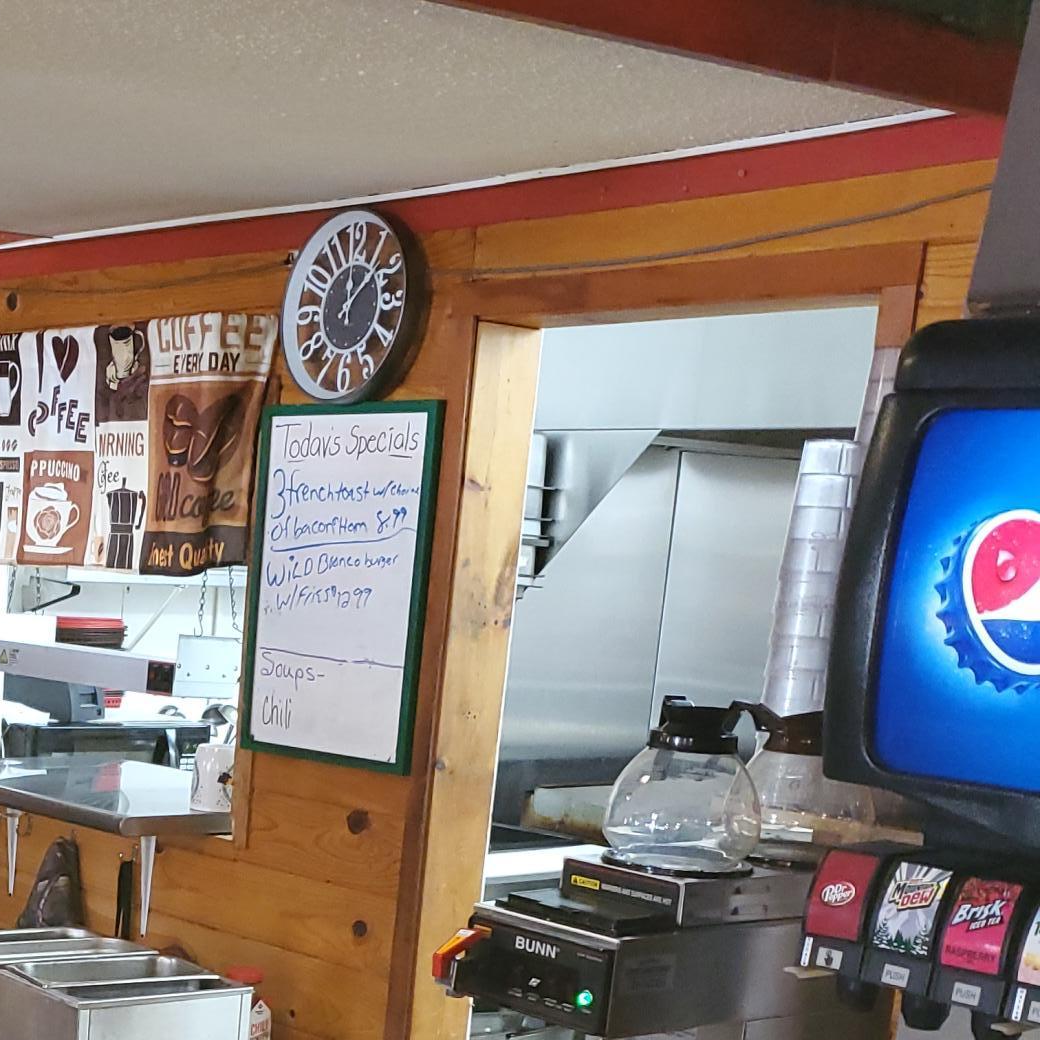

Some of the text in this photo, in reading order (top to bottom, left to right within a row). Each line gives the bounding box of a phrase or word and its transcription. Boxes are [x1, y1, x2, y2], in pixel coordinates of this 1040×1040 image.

[323, 233, 347, 275] 11
[347, 222, 367, 265] 12
[368, 229, 390, 267] 1
[303, 264, 333, 299] 10
[375, 252, 402, 287] 2
[379, 289, 404, 311] 3
[297, 305, 322, 326] 9
[300, 331, 324, 361] 8
[374, 321, 394, 348] 4
[208, 351, 241, 373] DAY
[316, 348, 337, 386] 7
[335, 352, 351, 393] 6
[356, 342, 375, 379] 5
[345, 421, 420, 460] Specials
[262, 694, 292, 731] Chili
[822, 884, 853, 904] Pepper
[834, 884, 847, 893] Dr
[952, 899, 1006, 925] Brisk
[515, 935, 557, 959] BUNN
[946, 945, 996, 961] RASPBERRY
[885, 970, 905, 981] PUSH
[955, 988, 976, 1000] PUSH
